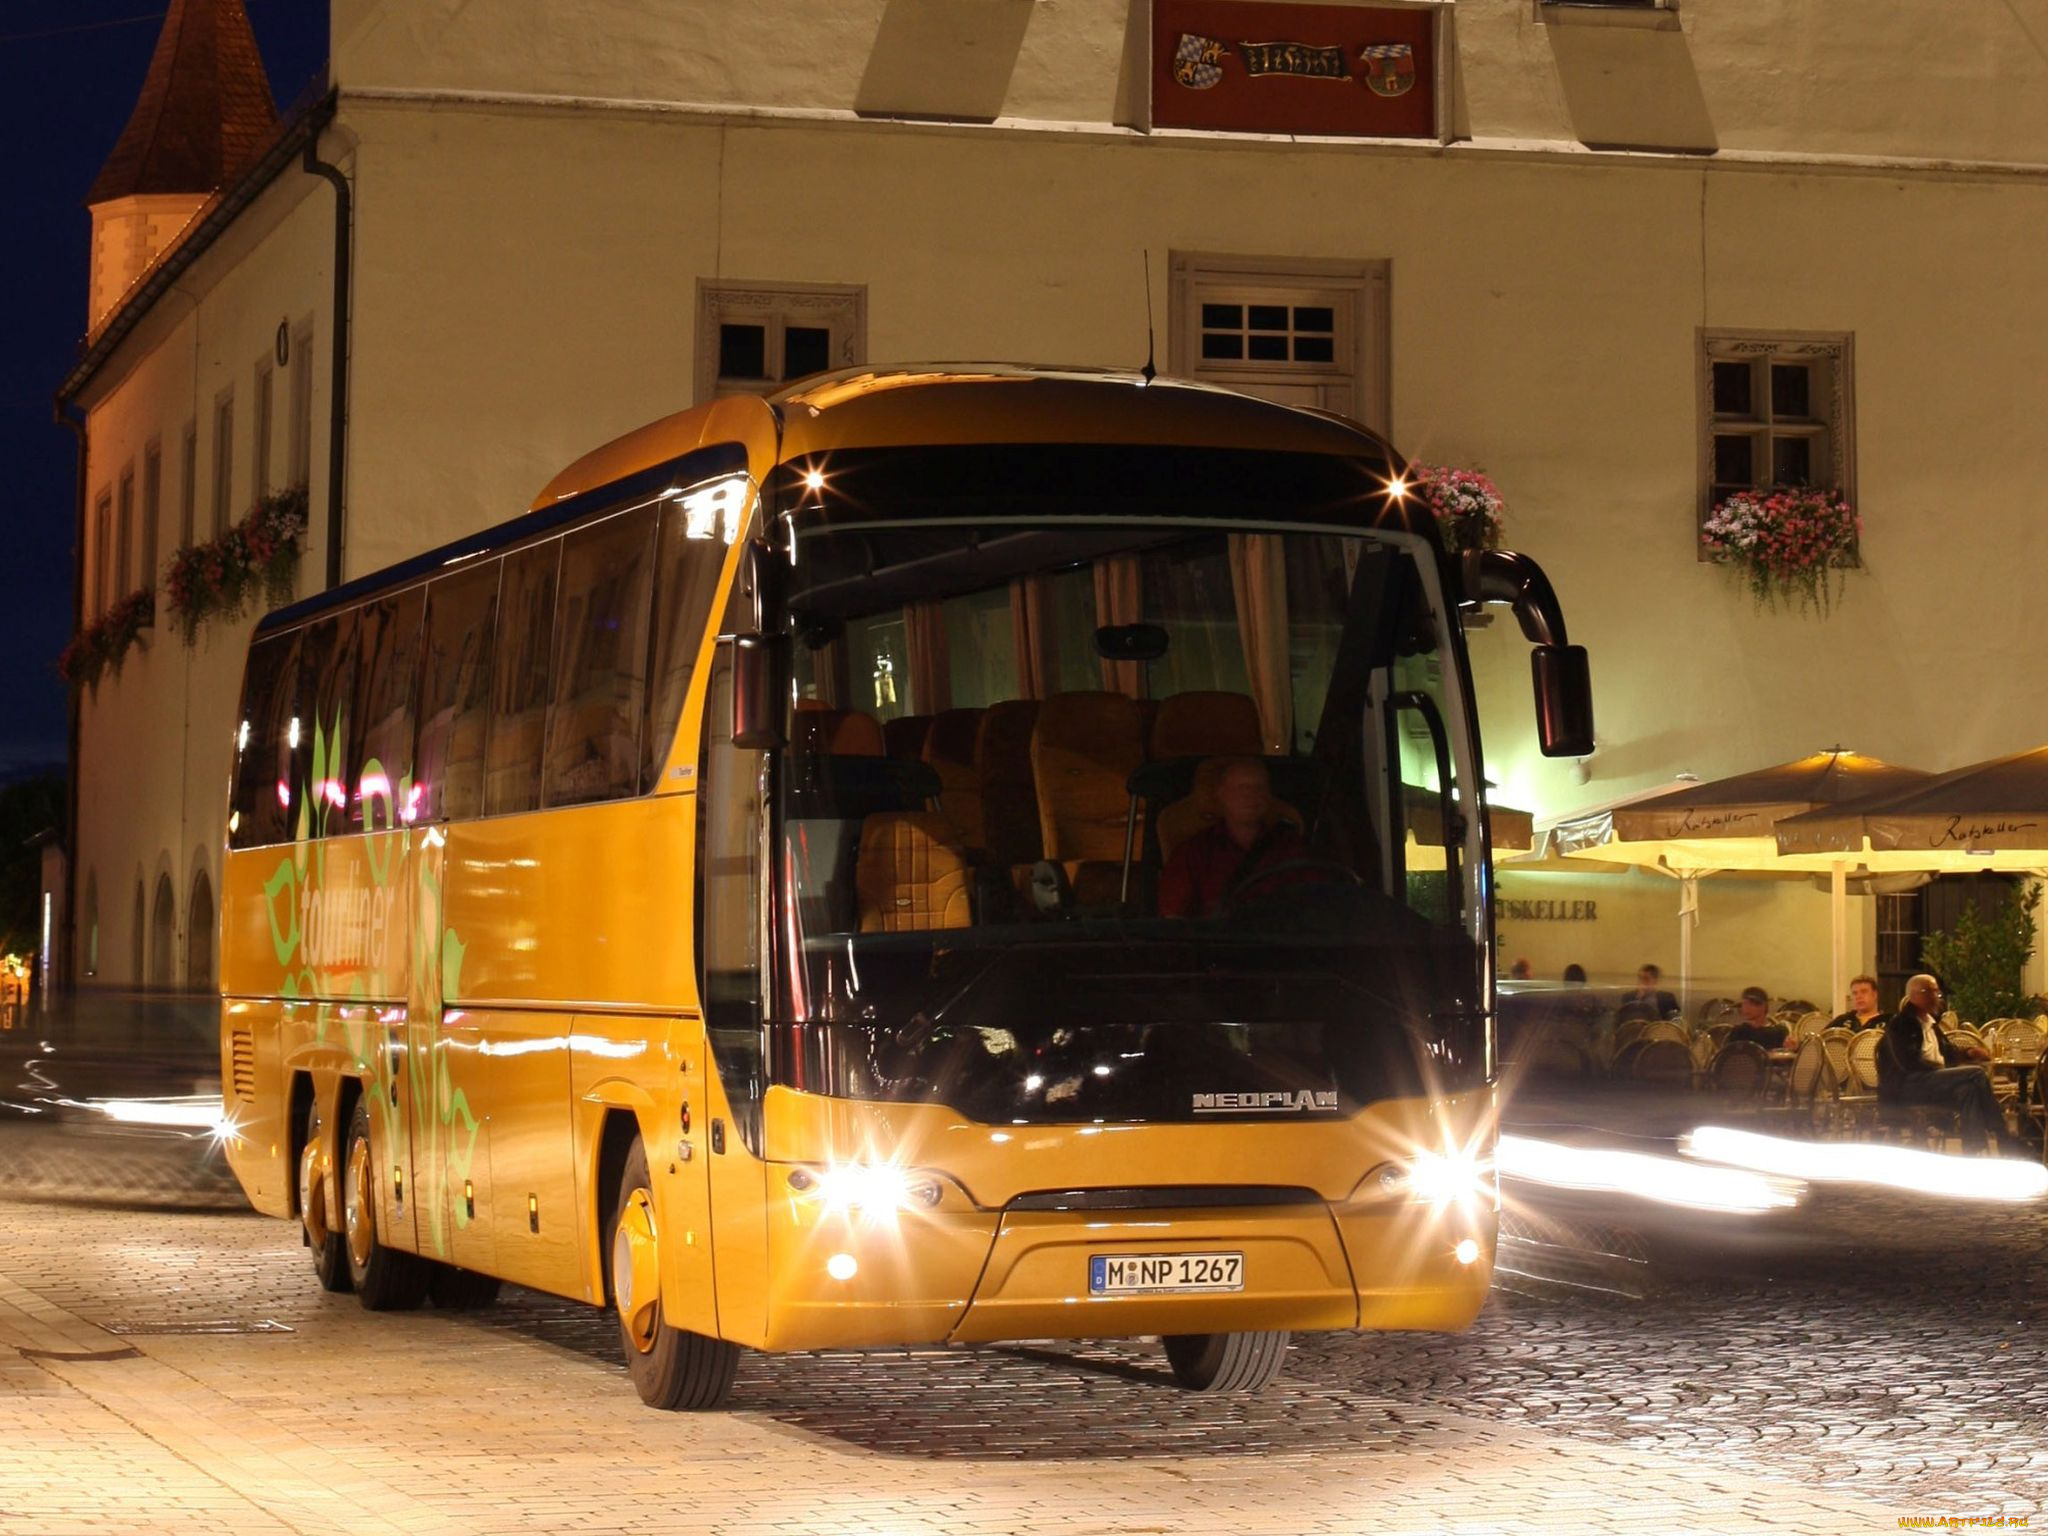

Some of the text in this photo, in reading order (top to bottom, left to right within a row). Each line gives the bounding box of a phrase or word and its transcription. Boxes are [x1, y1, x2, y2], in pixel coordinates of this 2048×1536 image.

[1929, 815, 2038, 848] Ratskeller
[1192, 1090, 1338, 1111] NEOPLAN
[1108, 1258, 1240, 1286] M NP 1267
